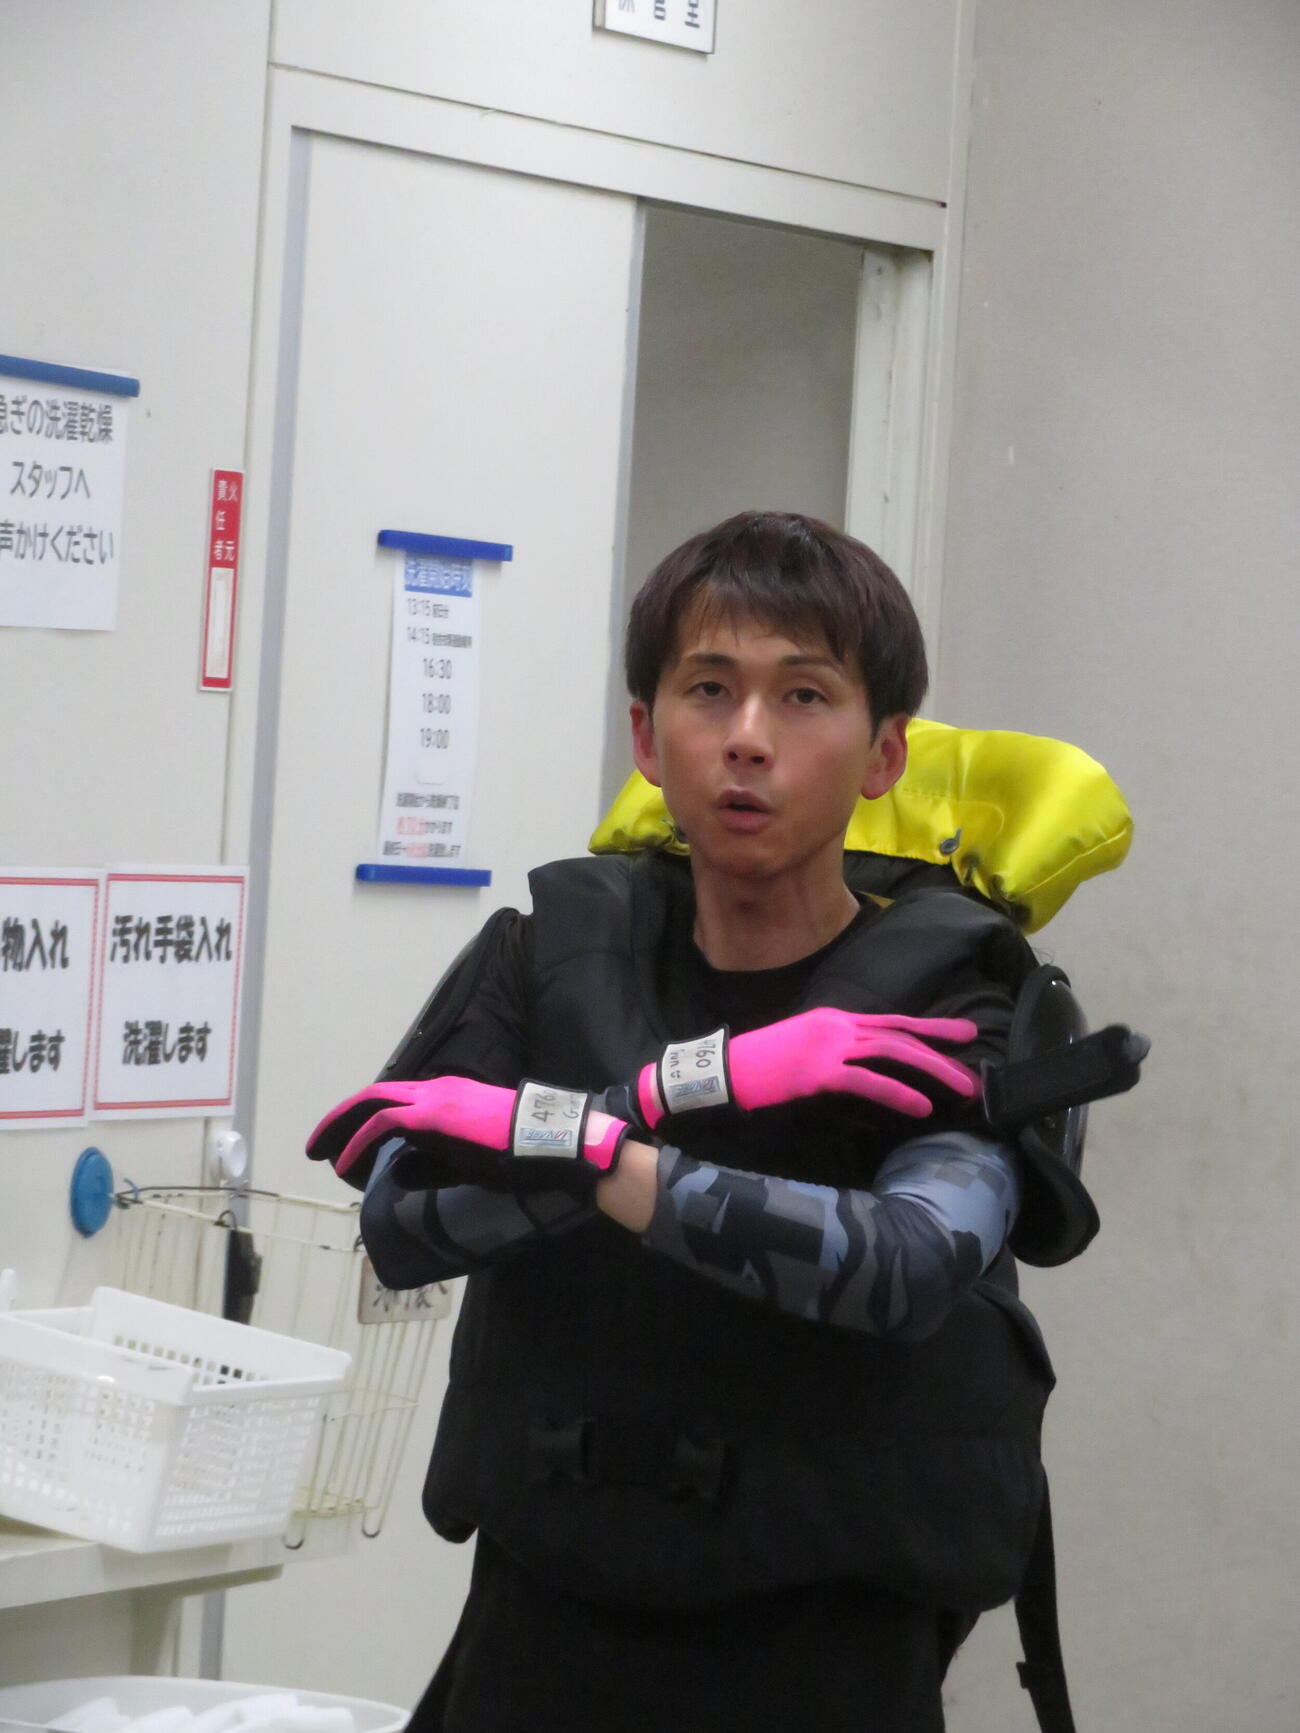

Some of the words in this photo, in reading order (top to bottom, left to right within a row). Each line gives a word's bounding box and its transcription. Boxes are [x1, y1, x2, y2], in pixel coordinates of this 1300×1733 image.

[10, 460, 91, 500] スタッフへ
[423, 658, 452, 679] 16:30
[420, 728, 449, 749] 19:00
[110, 915, 232, 963] 汚れ手袋入れ
[122, 1020, 212, 1066] 洗濯します
